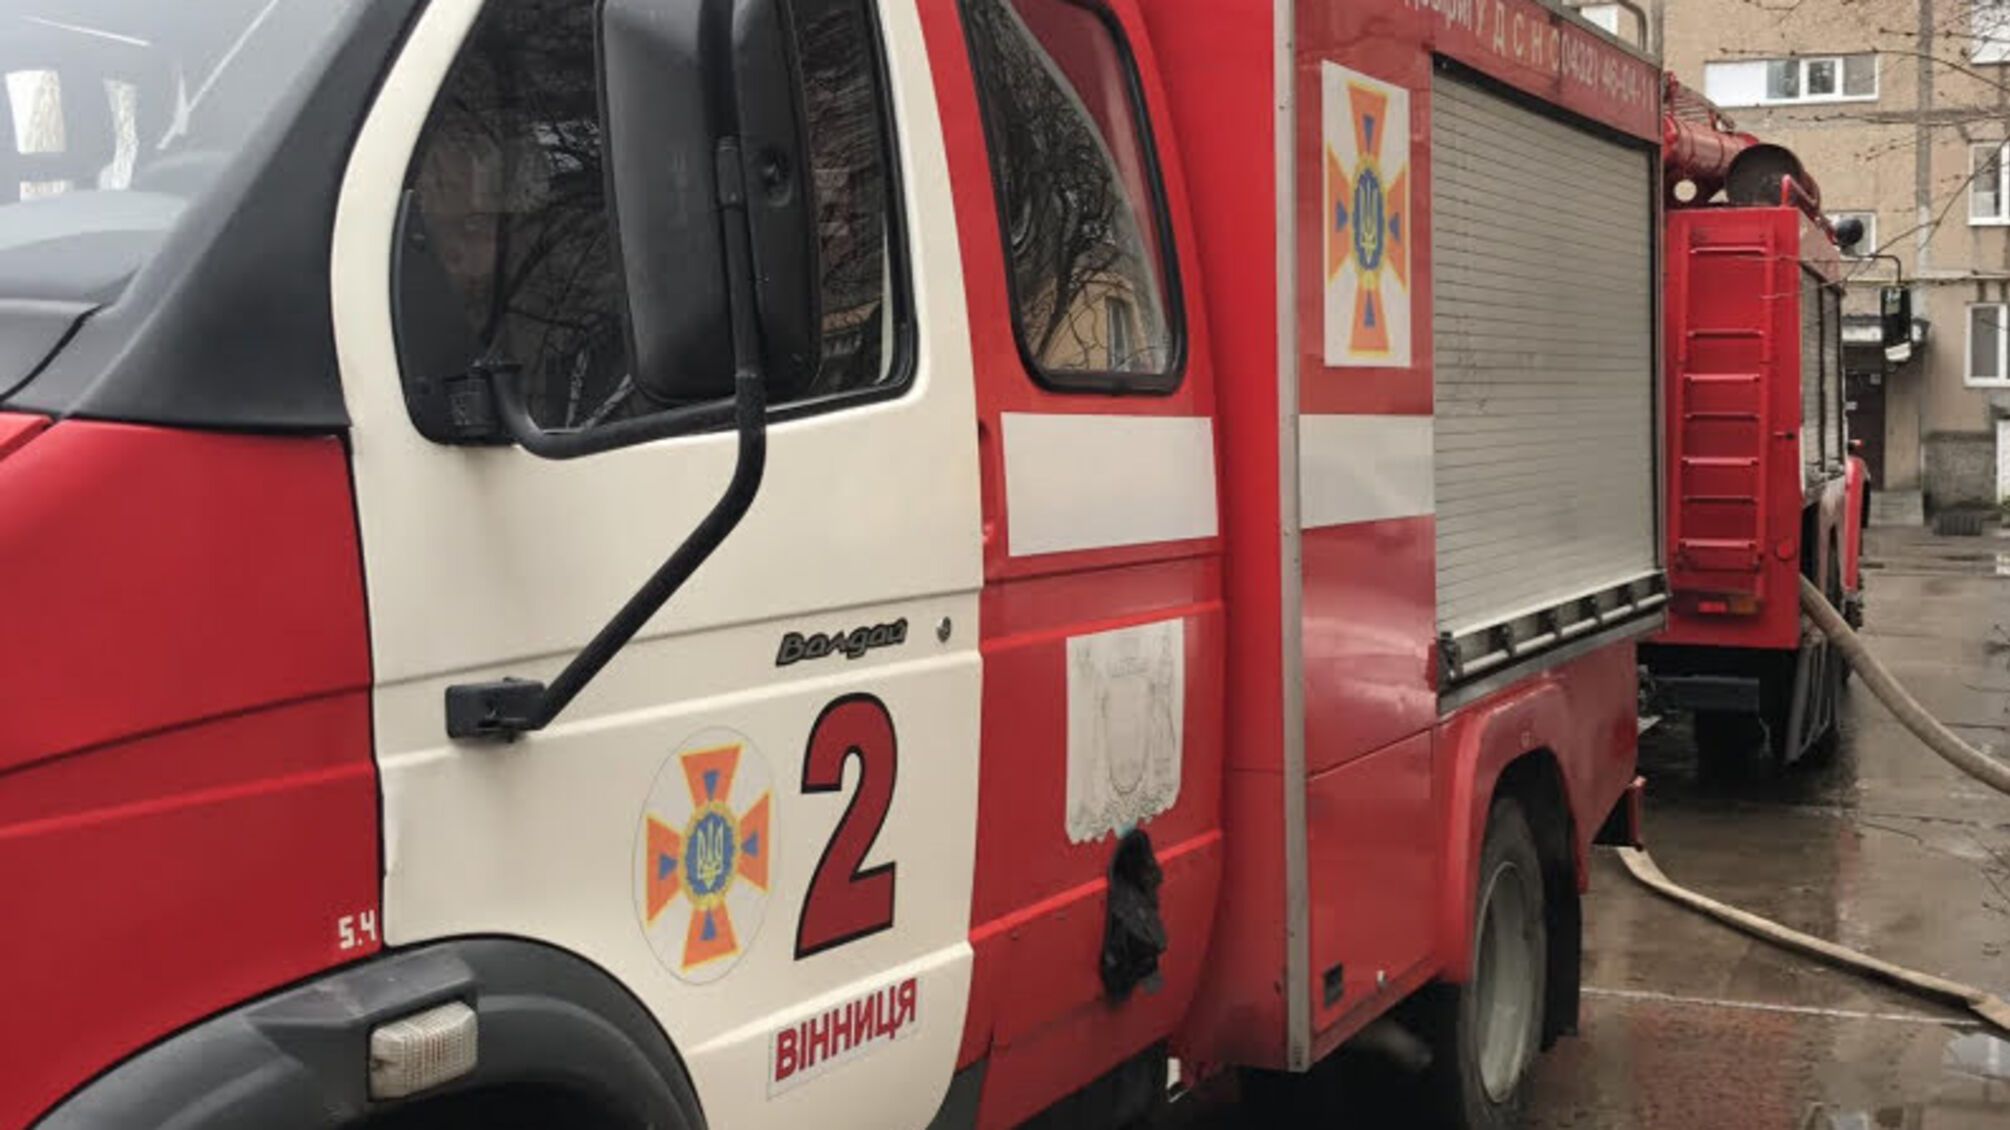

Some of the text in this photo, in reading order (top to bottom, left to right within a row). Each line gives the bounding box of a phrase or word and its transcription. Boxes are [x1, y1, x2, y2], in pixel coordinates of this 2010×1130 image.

[794, 692, 898, 961] 2
[338, 909, 376, 949] 5.4
[775, 977, 917, 1082] ВІННИЦЯ
